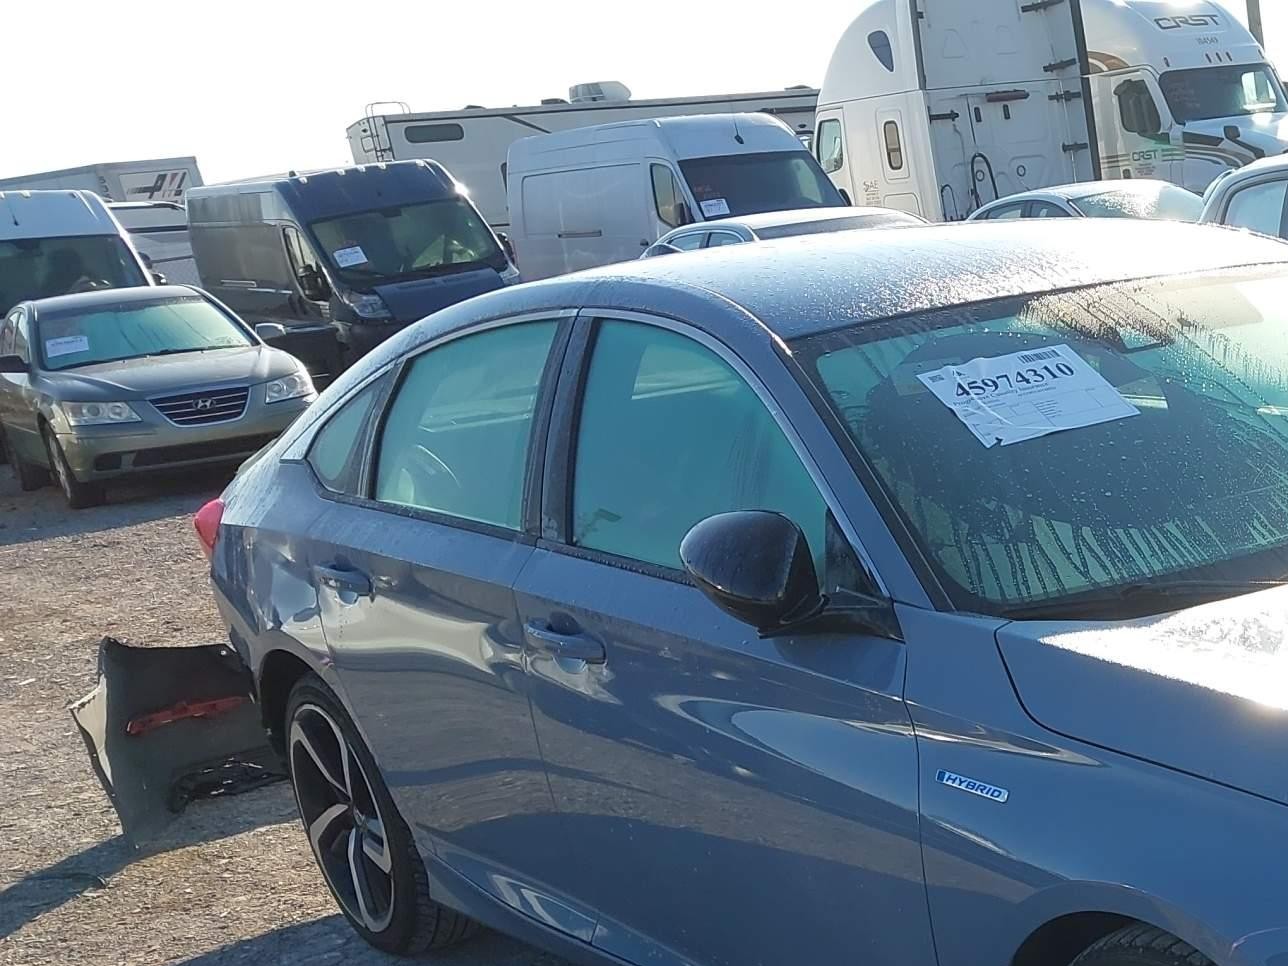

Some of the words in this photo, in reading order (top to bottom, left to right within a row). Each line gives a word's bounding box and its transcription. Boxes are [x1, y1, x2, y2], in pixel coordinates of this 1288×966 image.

[1153, 14, 1220, 30] CRST
[955, 362, 1075, 397] 45974310
[945, 774, 1003, 799] HYBRID
